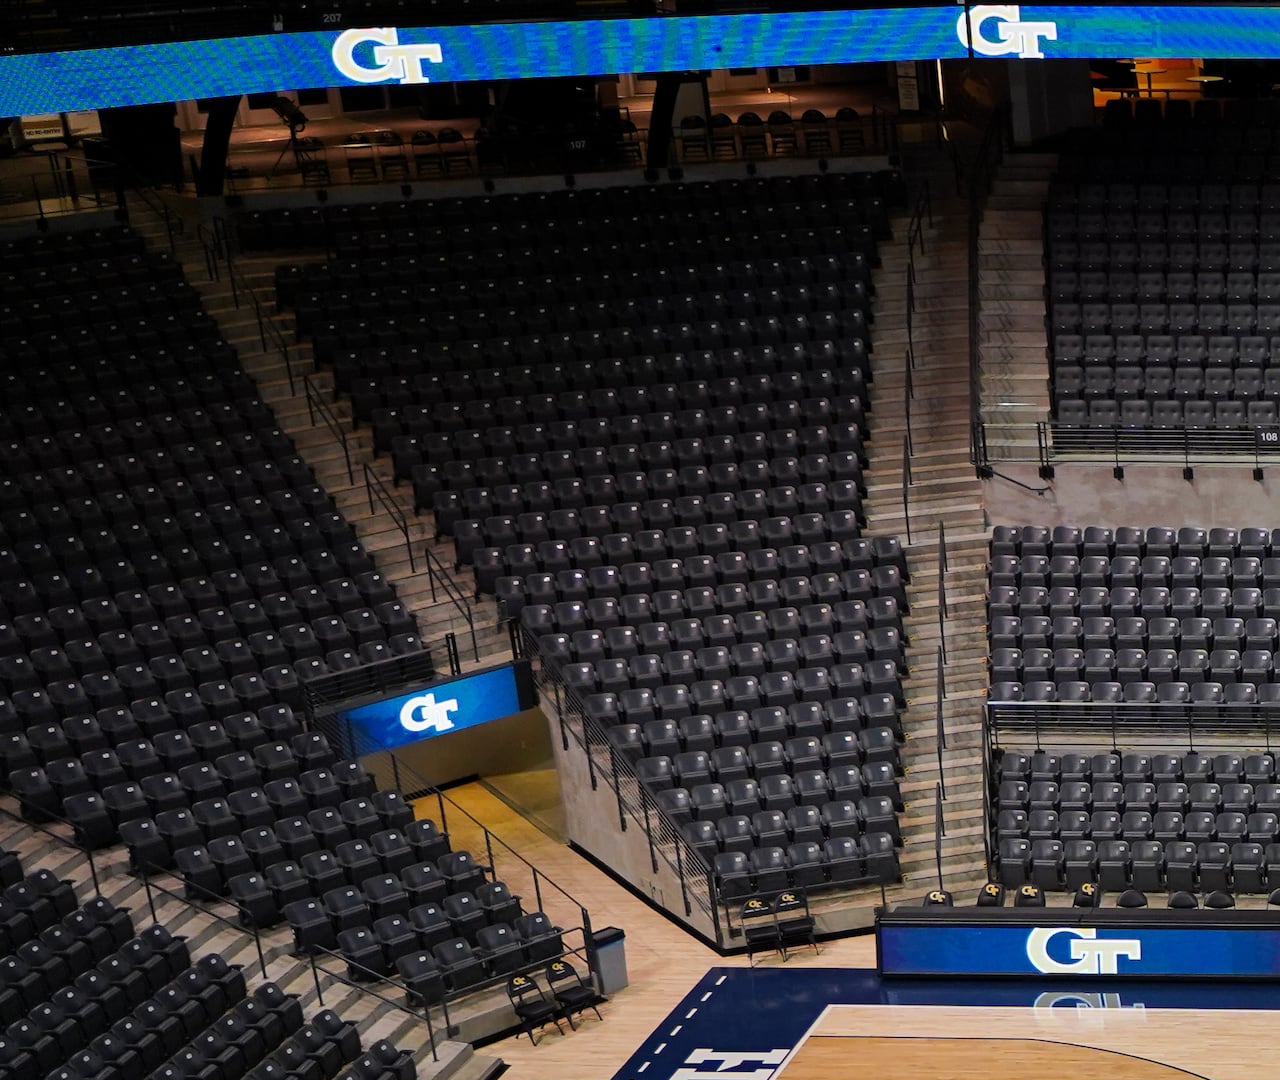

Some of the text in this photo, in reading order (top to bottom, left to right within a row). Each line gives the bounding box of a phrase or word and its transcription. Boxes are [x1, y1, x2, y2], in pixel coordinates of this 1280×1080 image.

[321, 13, 342, 23] 207
[957, 4, 1057, 59] GT
[332, 27, 443, 84] GT
[570, 140, 586, 150] 107
[1260, 432, 1278, 441] 108
[400, 693, 459, 732] GT
[1026, 927, 1141, 974] GT
